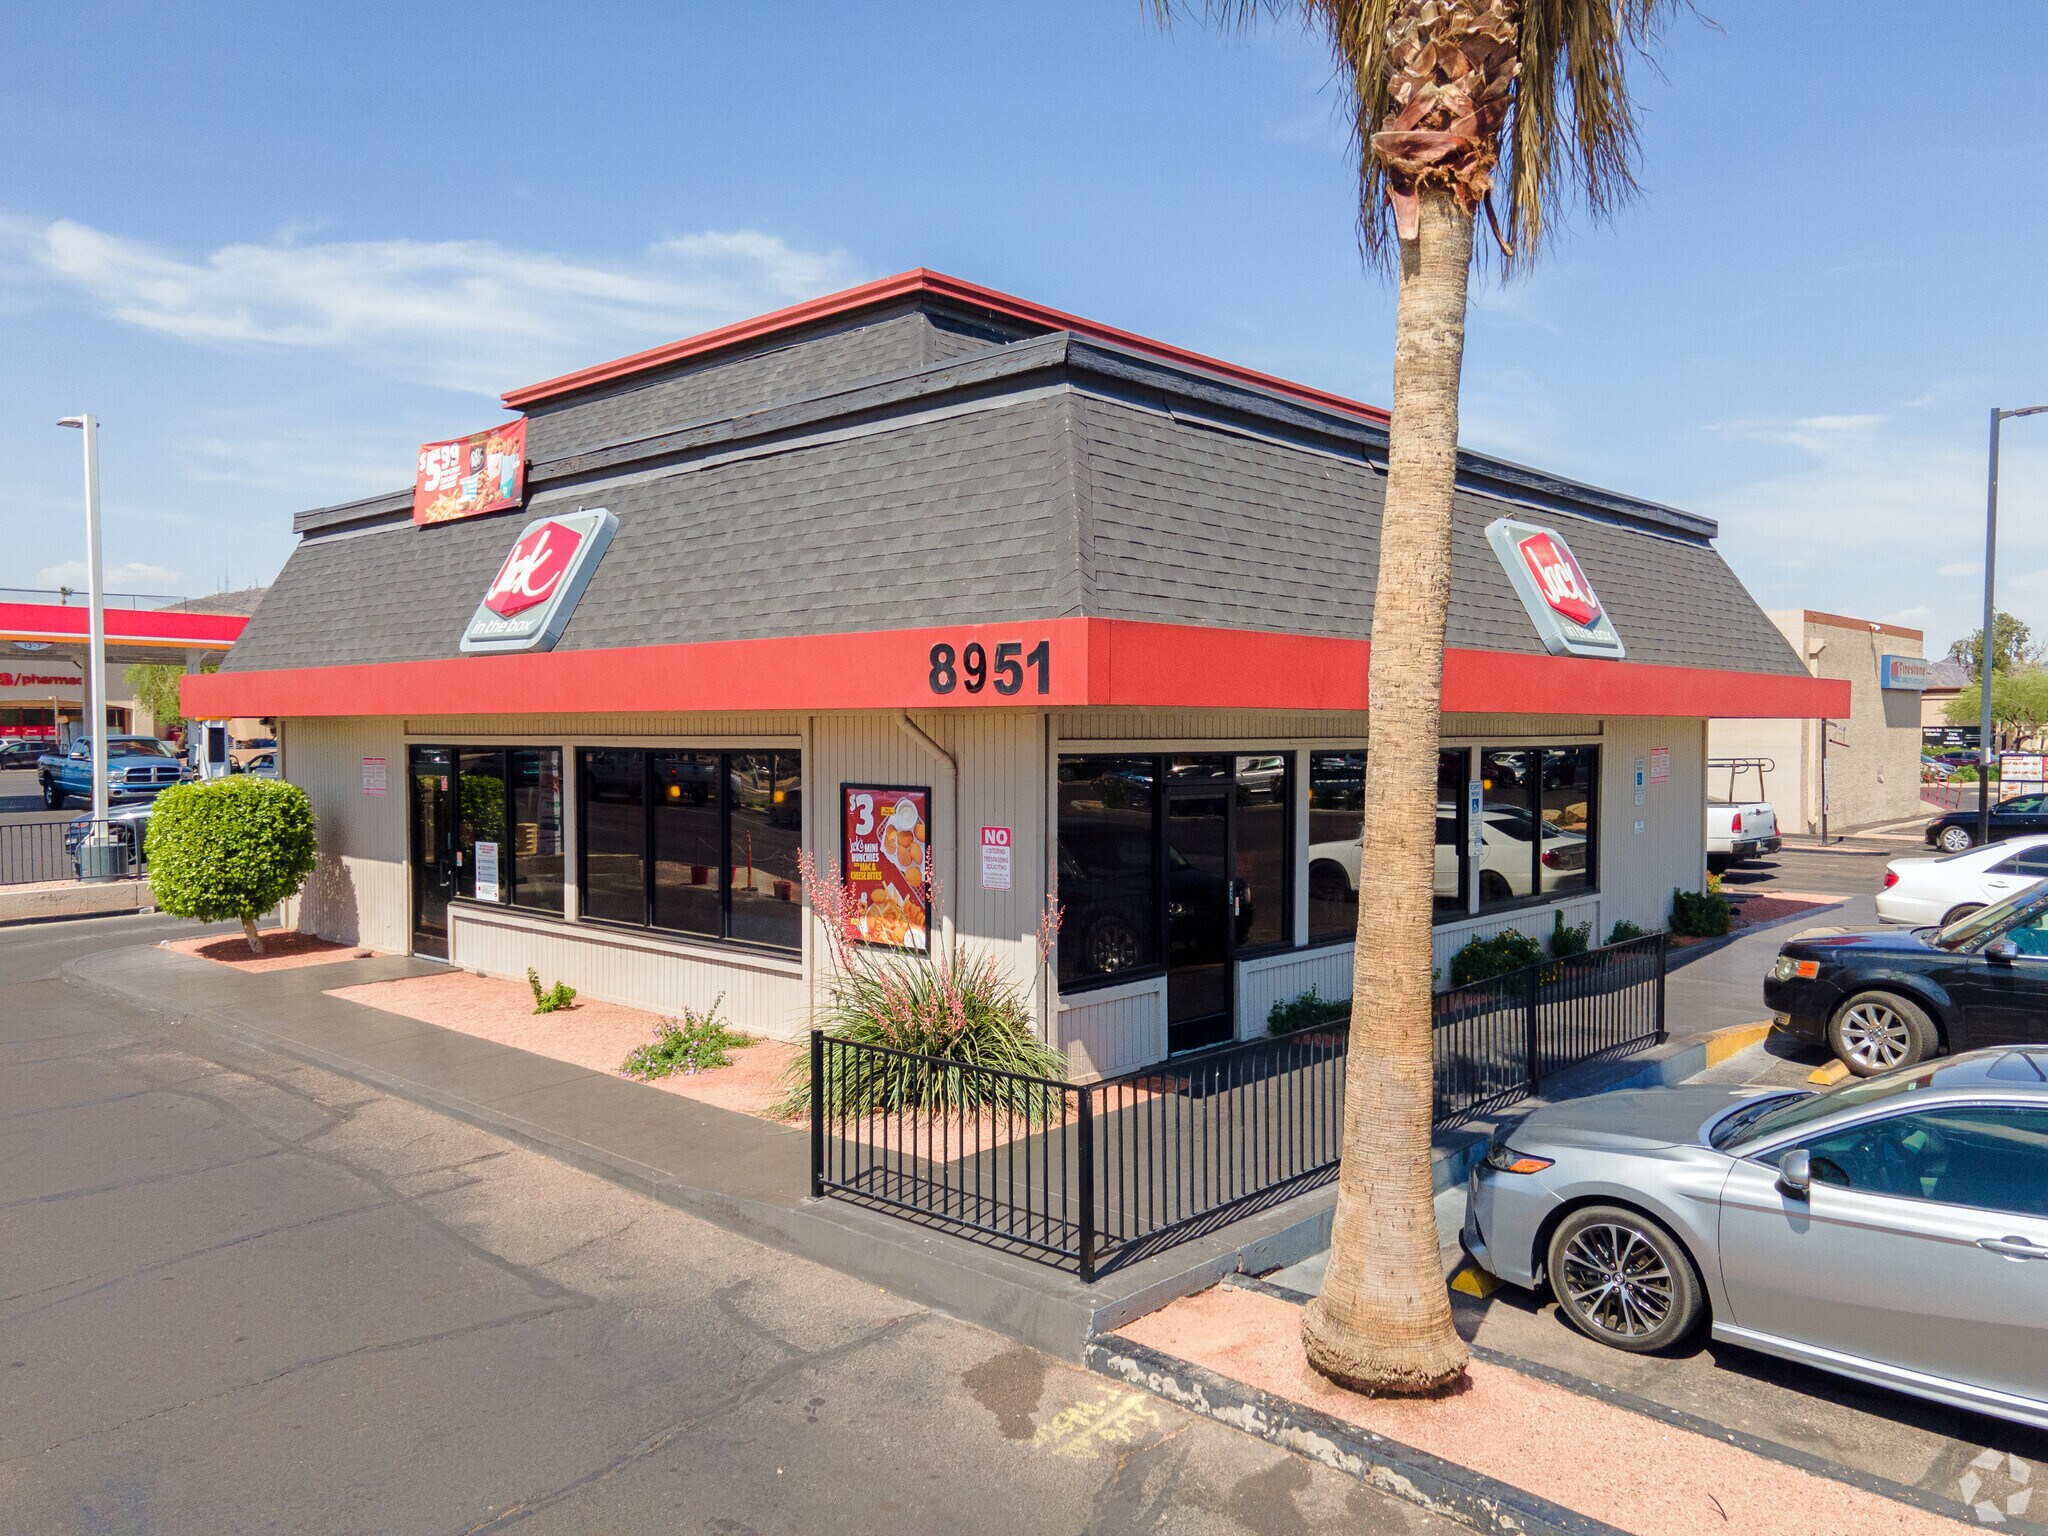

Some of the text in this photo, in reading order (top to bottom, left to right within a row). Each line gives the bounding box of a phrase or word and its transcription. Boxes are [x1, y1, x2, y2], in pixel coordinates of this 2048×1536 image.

[487, 530, 560, 601] Jack
[1525, 541, 1596, 609] Jack
[471, 619, 533, 634] in the box
[929, 640, 1050, 695] 8951
[1899, 661, 1926, 676] Firestone
[849, 793, 874, 836] $3
[984, 829, 1008, 845] NO
[851, 853, 880, 862] MUNCHIES
[983, 855, 1009, 864] TRESPASSING
